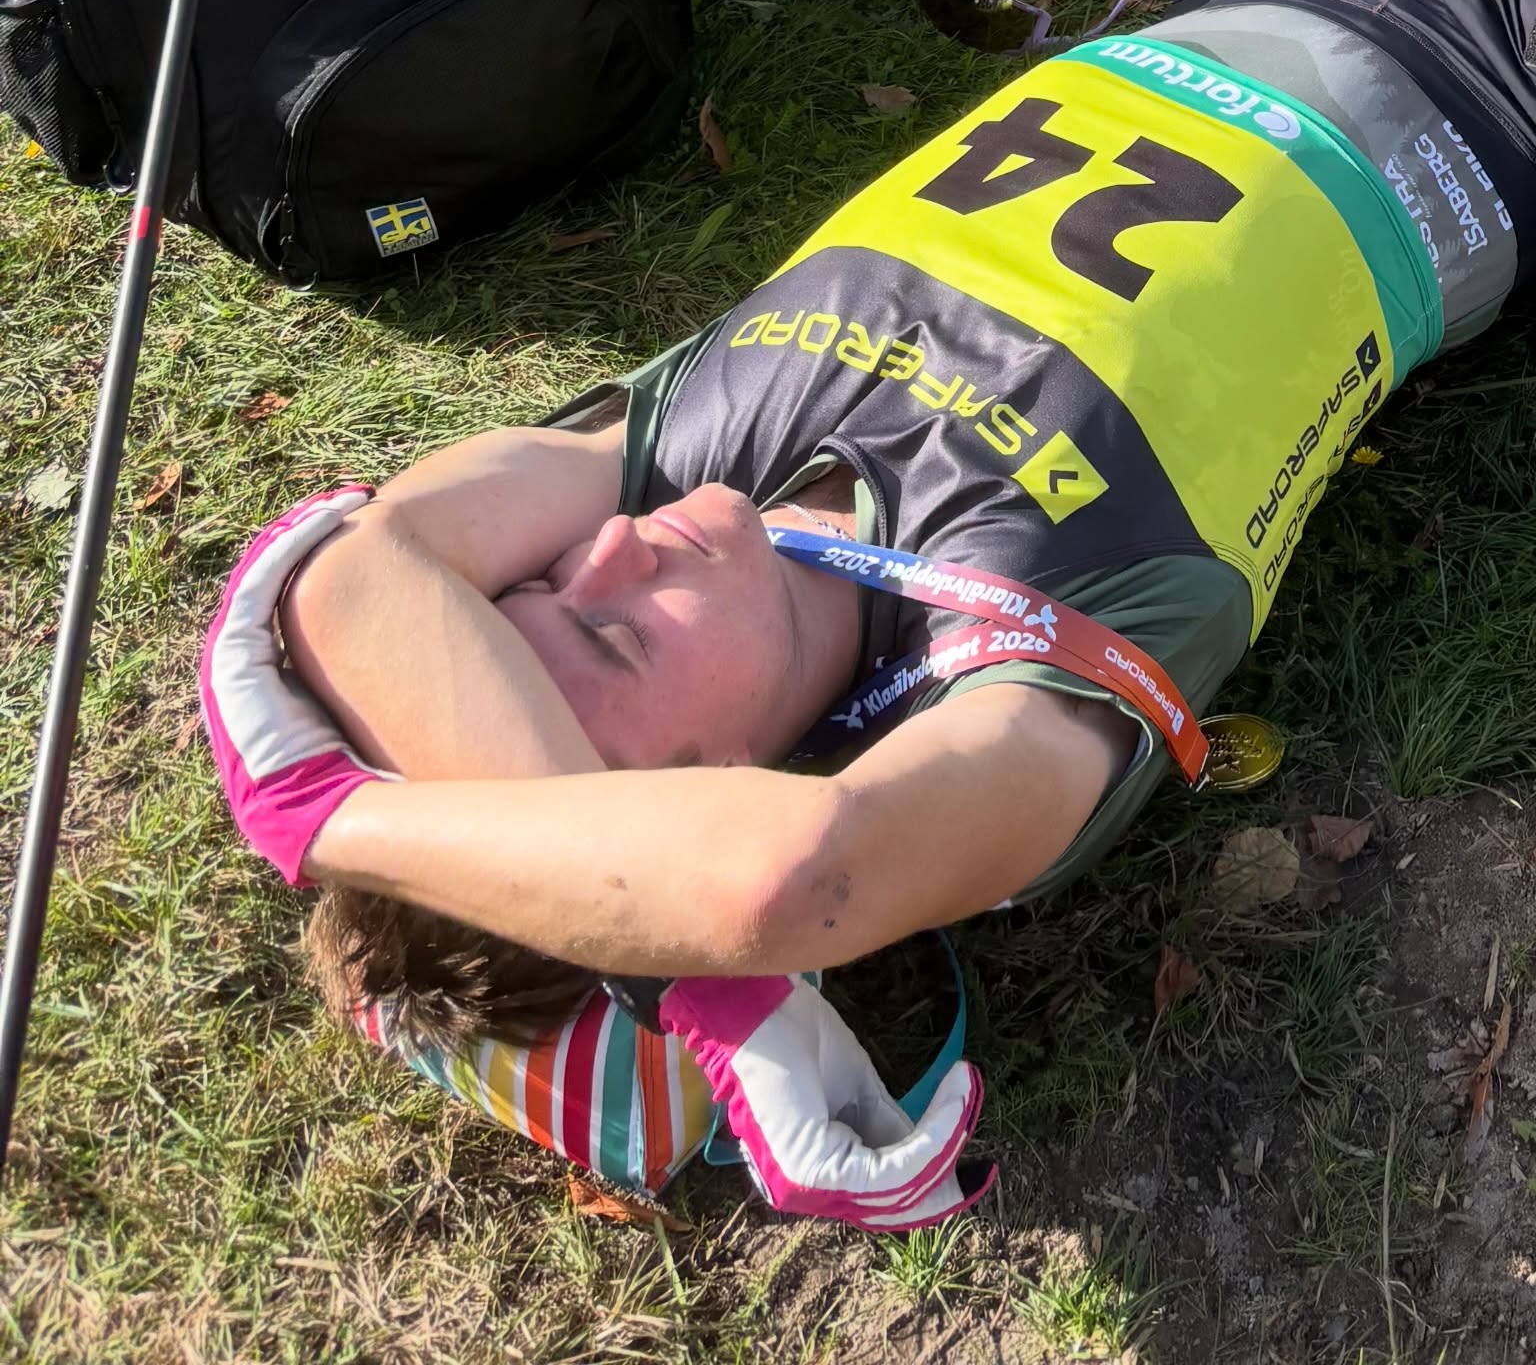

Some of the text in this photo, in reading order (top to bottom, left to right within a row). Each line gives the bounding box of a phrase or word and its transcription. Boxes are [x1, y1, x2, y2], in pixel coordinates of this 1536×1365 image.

[1098, 42, 1262, 116] fortum
[914, 98, 1244, 303] 24
[1383, 158, 1442, 269] ESTRA
[730, 311, 1039, 459] SAFEROAD
[1246, 365, 1361, 550] SAFEROAD
[818, 546, 1031, 619] Klarälvsloppet 2026
[863, 629, 1051, 719] Klarälvsloppet 2026
[1104, 646, 1176, 719] SAFEROAD
